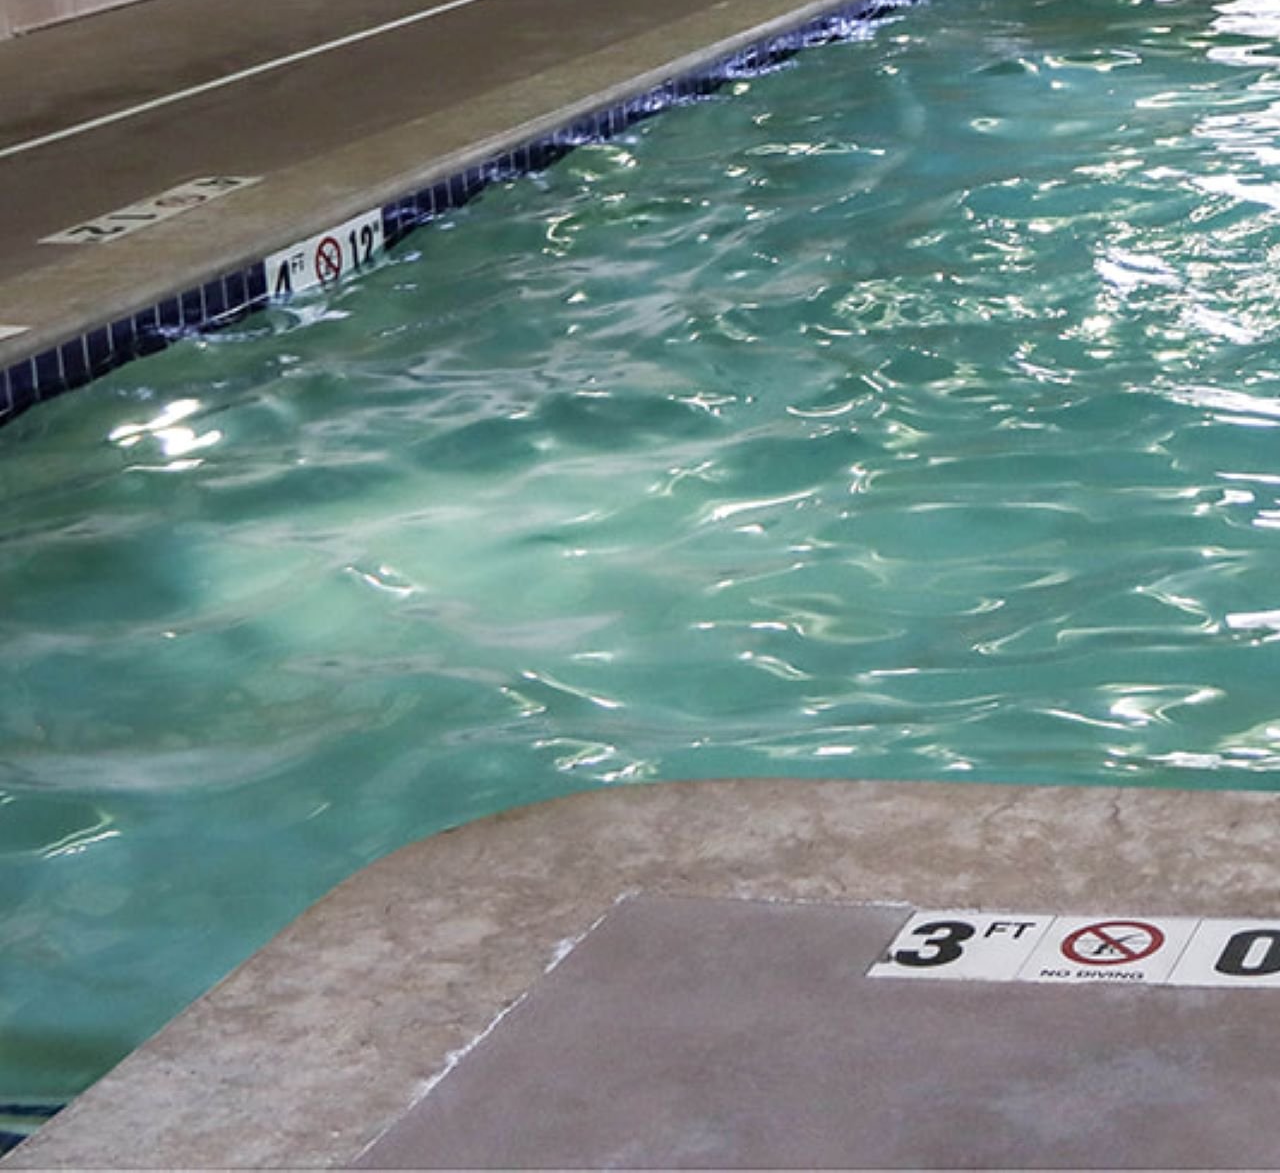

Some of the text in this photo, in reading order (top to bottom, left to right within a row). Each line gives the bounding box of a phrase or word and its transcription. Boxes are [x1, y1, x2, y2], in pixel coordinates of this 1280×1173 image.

[984, 922, 1036, 939] FT
[1040, 969, 1071, 978] NO
[1076, 970, 1146, 980] DIVING
